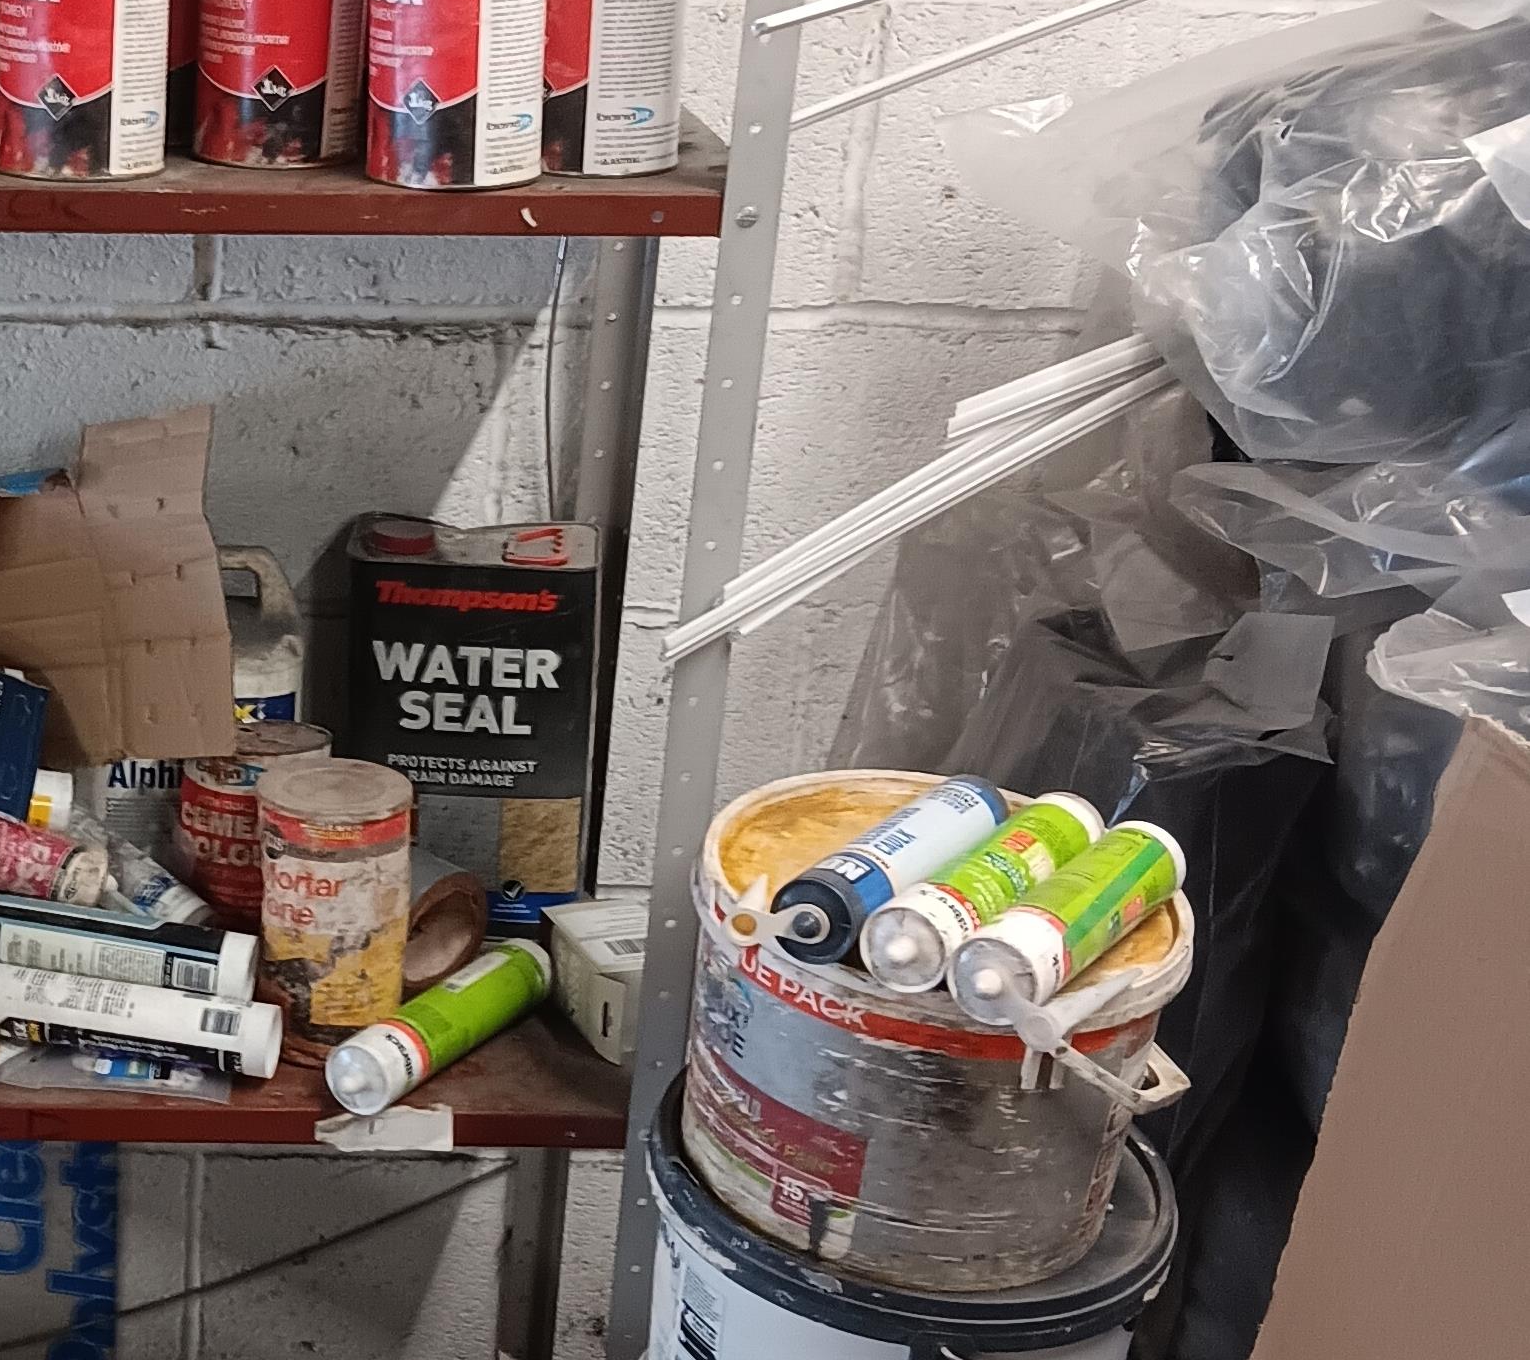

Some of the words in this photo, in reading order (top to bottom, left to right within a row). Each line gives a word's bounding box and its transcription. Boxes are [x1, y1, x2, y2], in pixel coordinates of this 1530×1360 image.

[375, 580, 559, 613] Thompson's
[372, 640, 562, 689] WATER
[399, 690, 532, 735] SEAL
[387, 753, 466, 771] PROTECTS
[469, 759, 539, 773] AGAINST
[408, 770, 446, 784] RAIN
[450, 772, 515, 788] DAMAGE
[874, 828, 918, 857] CAULK
[269, 865, 347, 899] ortar
[778, 978, 870, 1030] PACK
